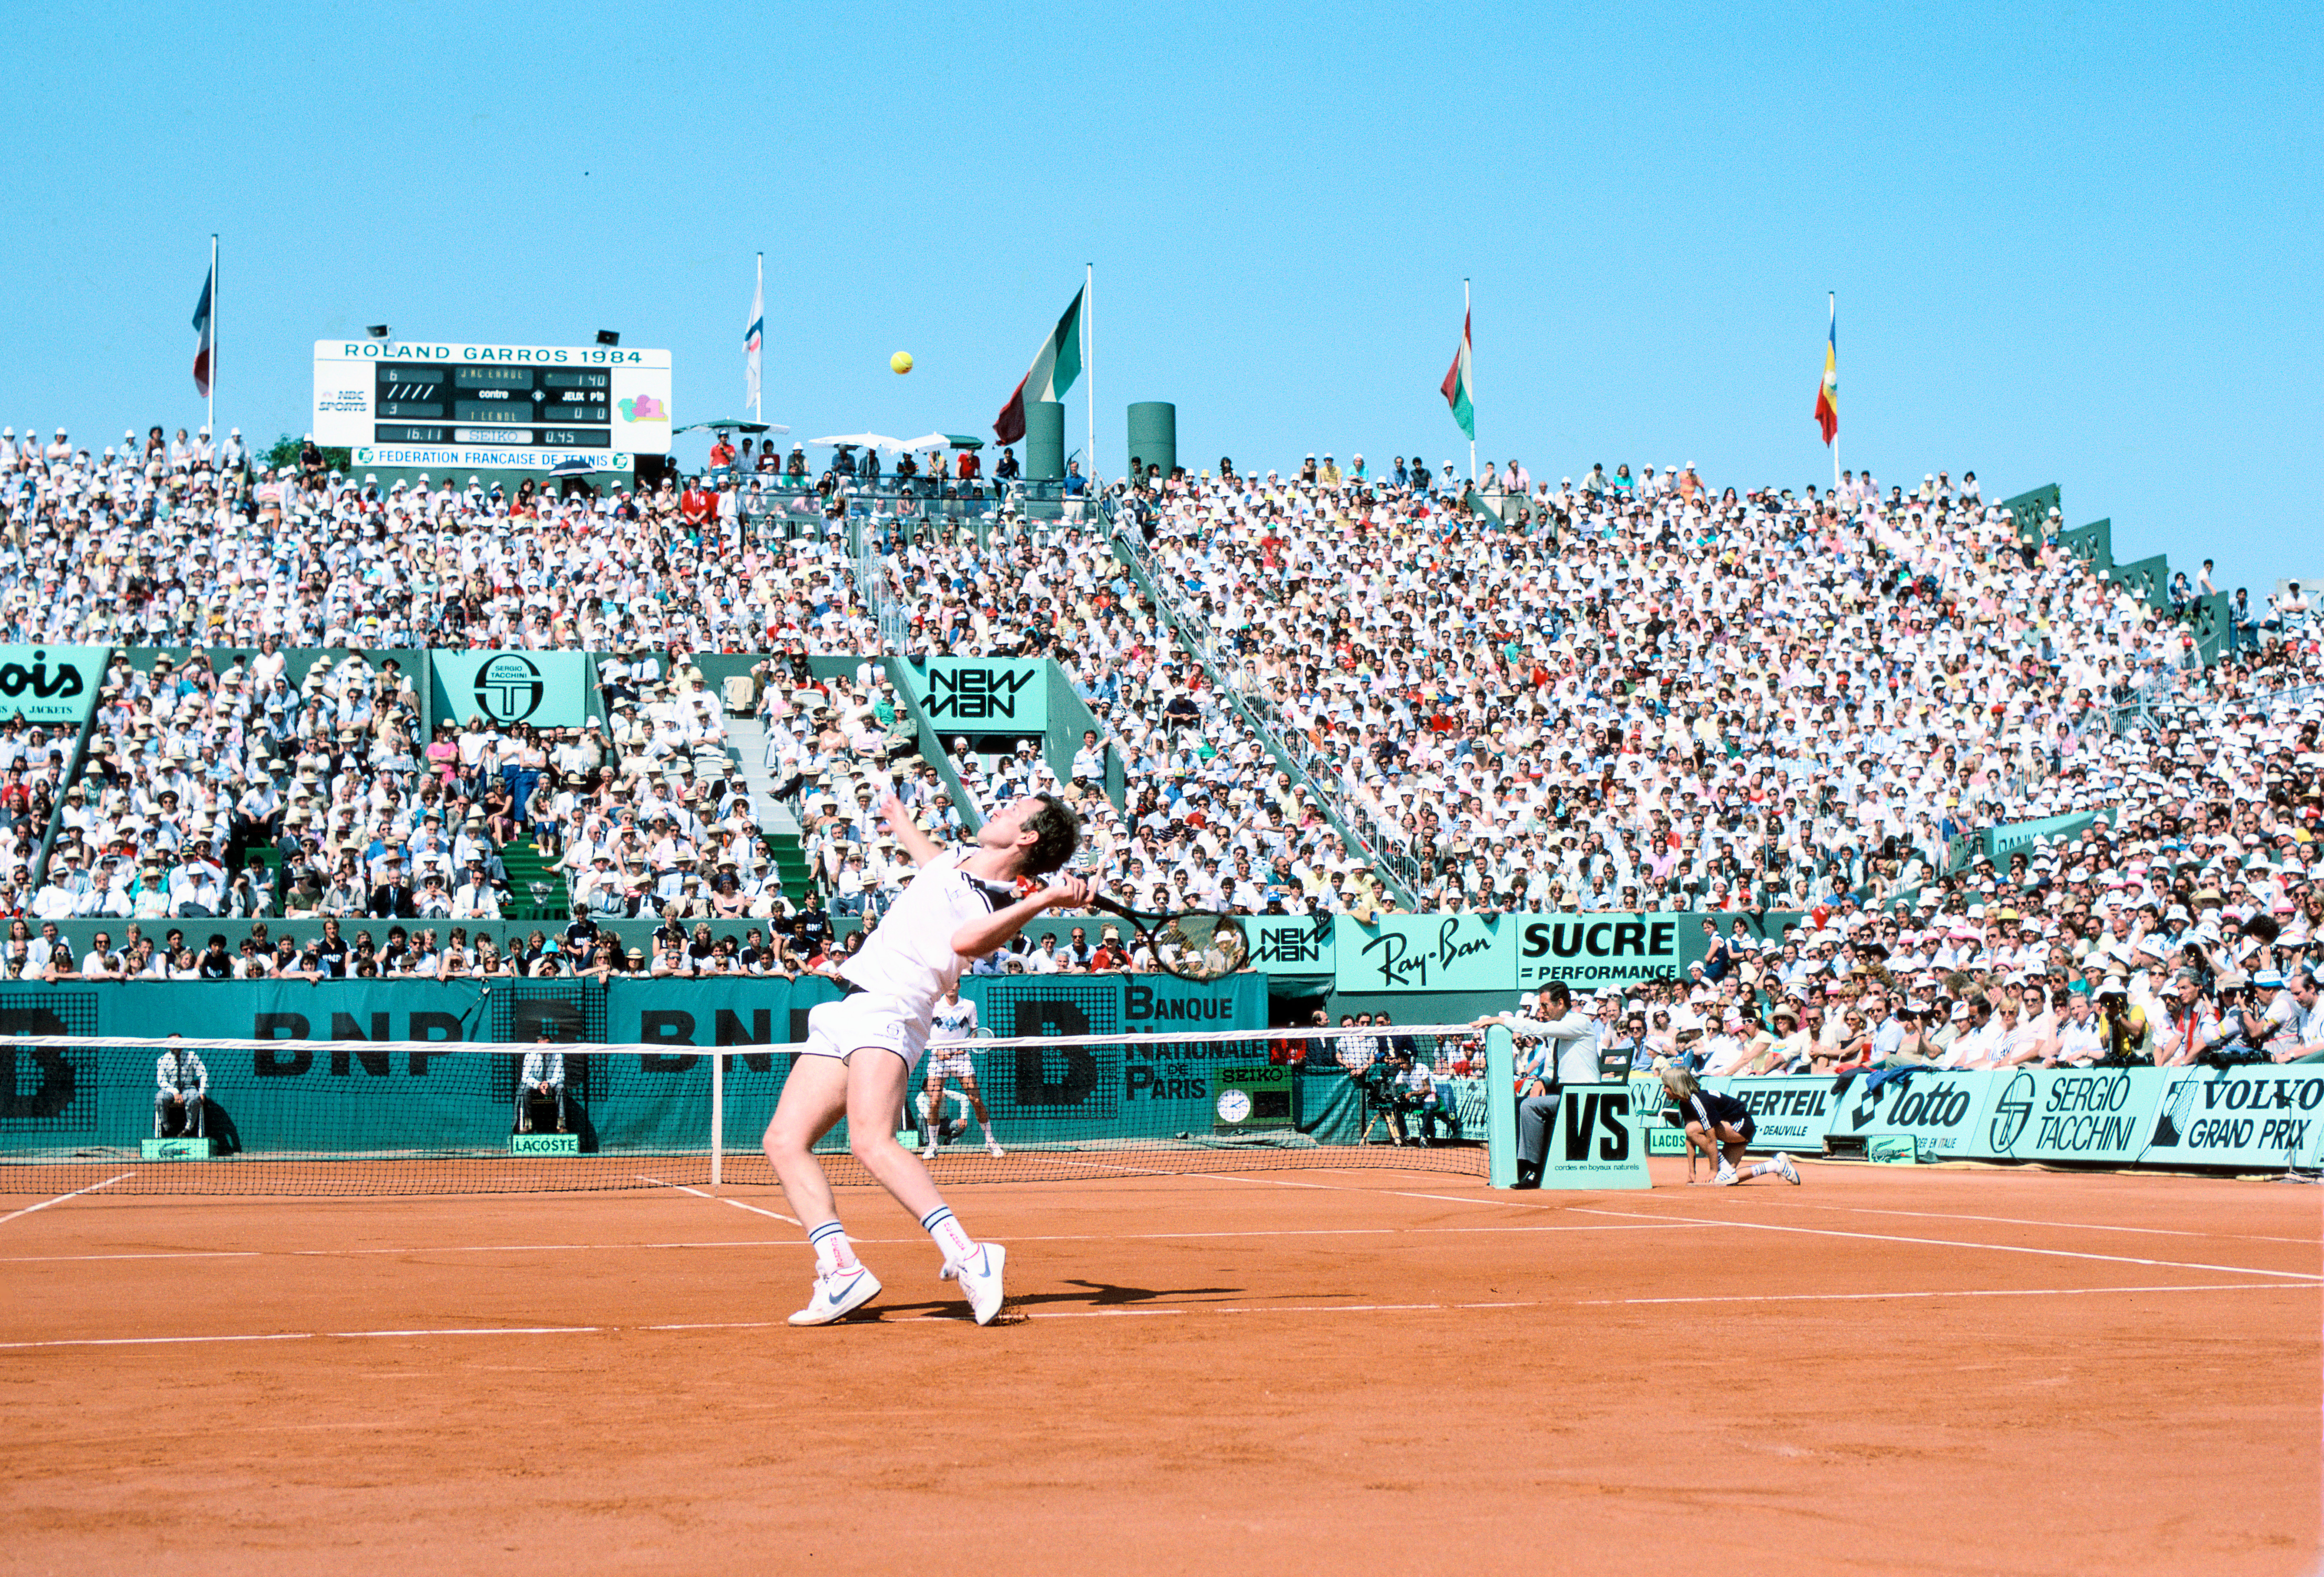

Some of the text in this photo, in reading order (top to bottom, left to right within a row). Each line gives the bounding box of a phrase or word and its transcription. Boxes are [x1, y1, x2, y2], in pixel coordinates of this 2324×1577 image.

[345, 344, 642, 363] ROLAND GARROS 1984
[390, 370, 398, 381] 6
[589, 375, 605, 387] 40
[338, 390, 364, 400] NBC
[479, 389, 509, 399] contre
[562, 391, 584, 401] JEUX
[319, 402, 367, 411] SPORTS
[389, 402, 397, 414] 3
[481, 411, 516, 421] LENDL
[574, 407, 605, 419] 0 0
[407, 428, 441, 440] 16.11
[469, 430, 518, 441] SEIKO
[379, 451, 458, 463] FEDERATION
[542, 454, 558, 465] DE
[29, 705, 73, 714] JACKETS
[1522, 922, 1676, 958] SUCRE
[1538, 965, 1677, 980] PERFORMANCE
[1125, 985, 1232, 1021] BANQUE
[254, 1012, 463, 1076] BNP
[1168, 1064, 1189, 1075] DE
[1222, 1067, 1283, 1083] SEIKO
[1126, 1065, 1206, 1101] PARIS
[2046, 1075, 2131, 1113] SERGIO
[2203, 1078, 2324, 1111] VOLVO
[1887, 1078, 1971, 1127] lotto
[1566, 1093, 1629, 1161] VS
[1763, 1126, 1808, 1136] DEAUVILLE
[2036, 1114, 2137, 1151] TACCHINI
[2188, 1119, 2312, 1150] GRAND PRIX
[515, 1139, 577, 1152] LACOSTE
[1653, 1135, 1685, 1147] LACOS
[1938, 1138, 1957, 1148] ITALIE
